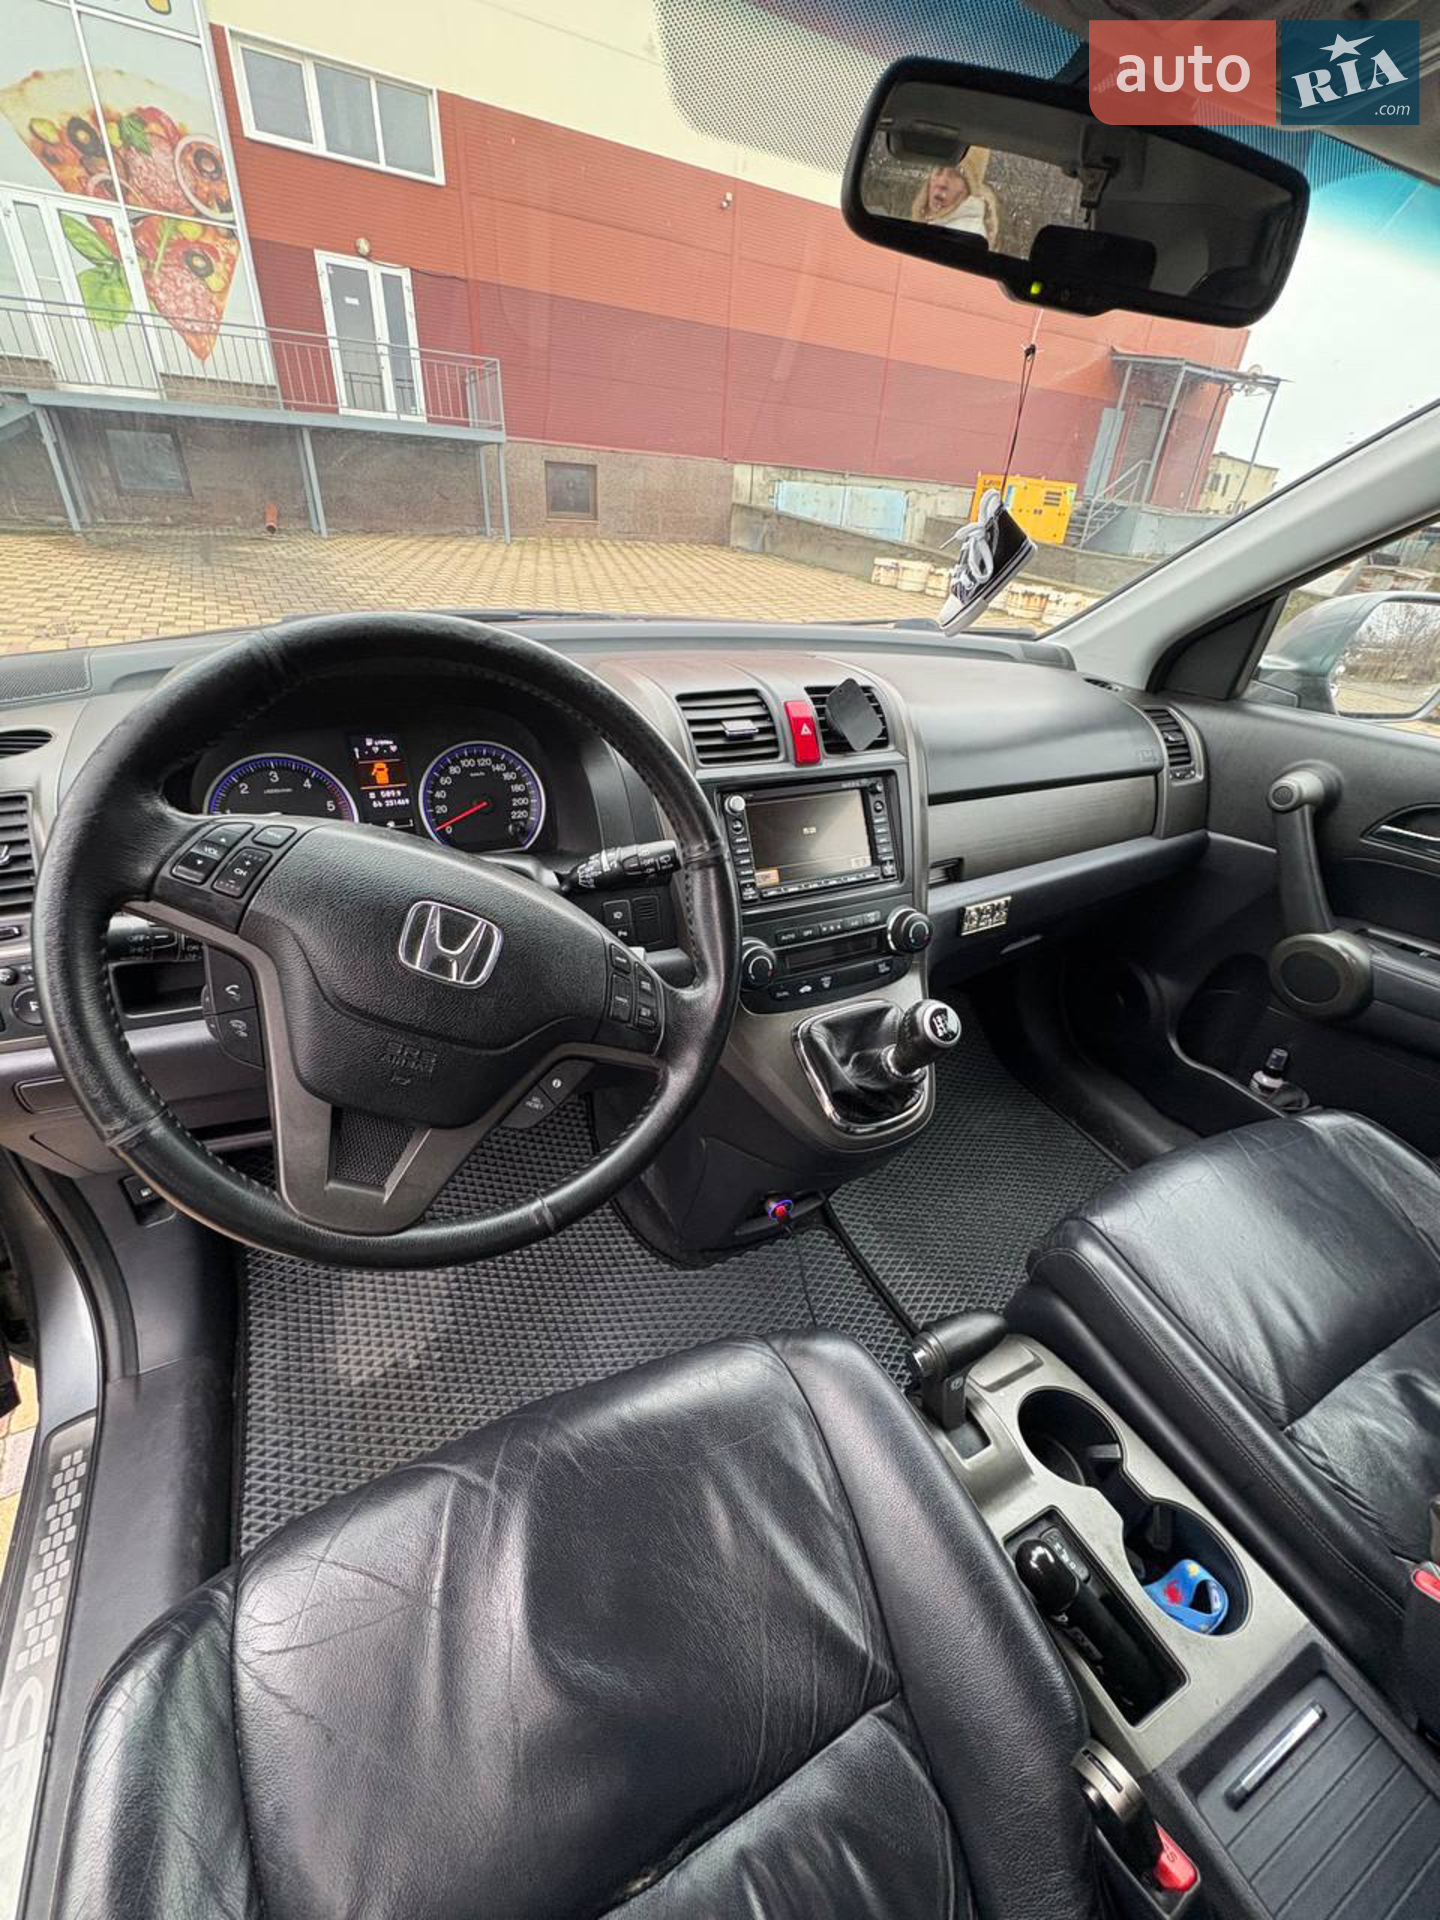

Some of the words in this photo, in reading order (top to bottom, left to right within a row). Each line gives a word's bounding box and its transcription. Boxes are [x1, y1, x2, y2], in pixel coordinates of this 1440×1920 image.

[460, 759, 475, 768] 100
[477, 757, 492, 766] 120
[449, 766, 461, 775] 80
[492, 764, 506, 772] 140
[268, 771, 279, 782] 3
[502, 772, 517, 780] 160
[303, 778, 312, 789] 4
[440, 777, 452, 785] 60
[240, 783, 249, 794] 2
[511, 784, 525, 792] 180
[434, 790, 446, 799] 40
[326, 801, 336, 811] 5
[512, 798, 529, 807] 200
[435, 805, 448, 814] 20
[511, 811, 528, 820] 220
[445, 825, 453, 834] 0
